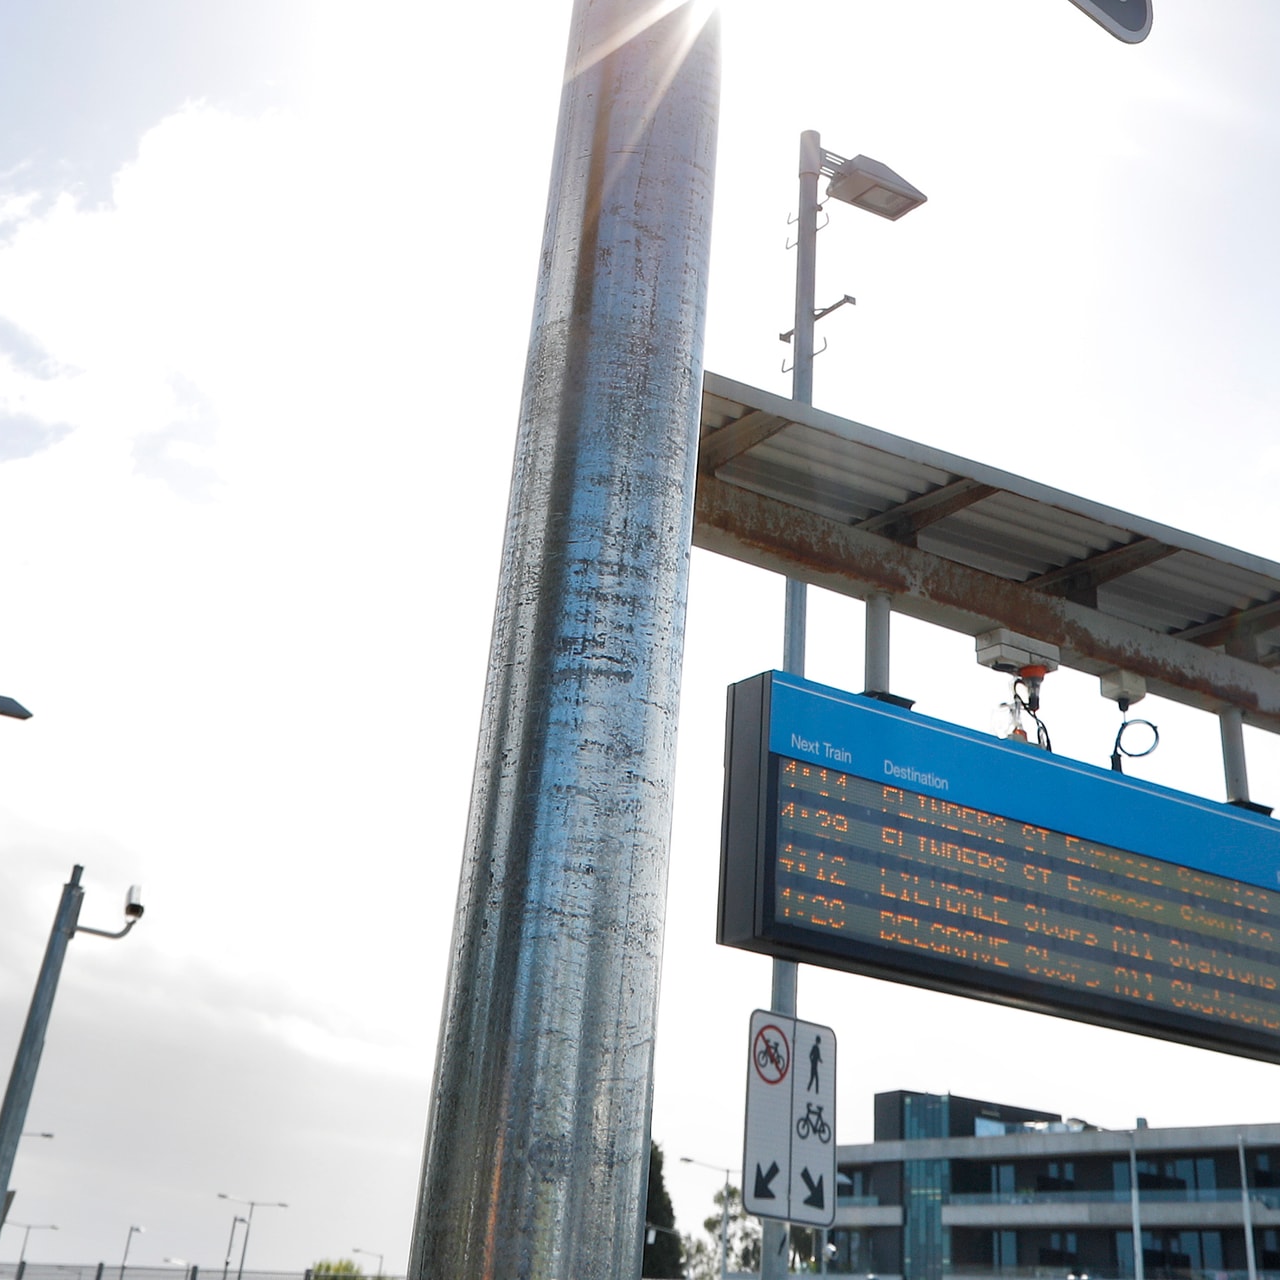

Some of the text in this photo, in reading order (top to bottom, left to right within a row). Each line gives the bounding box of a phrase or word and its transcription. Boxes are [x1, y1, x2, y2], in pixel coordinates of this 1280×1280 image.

[791, 733, 852, 763] Next Train
[883, 760, 949, 791] Destination
